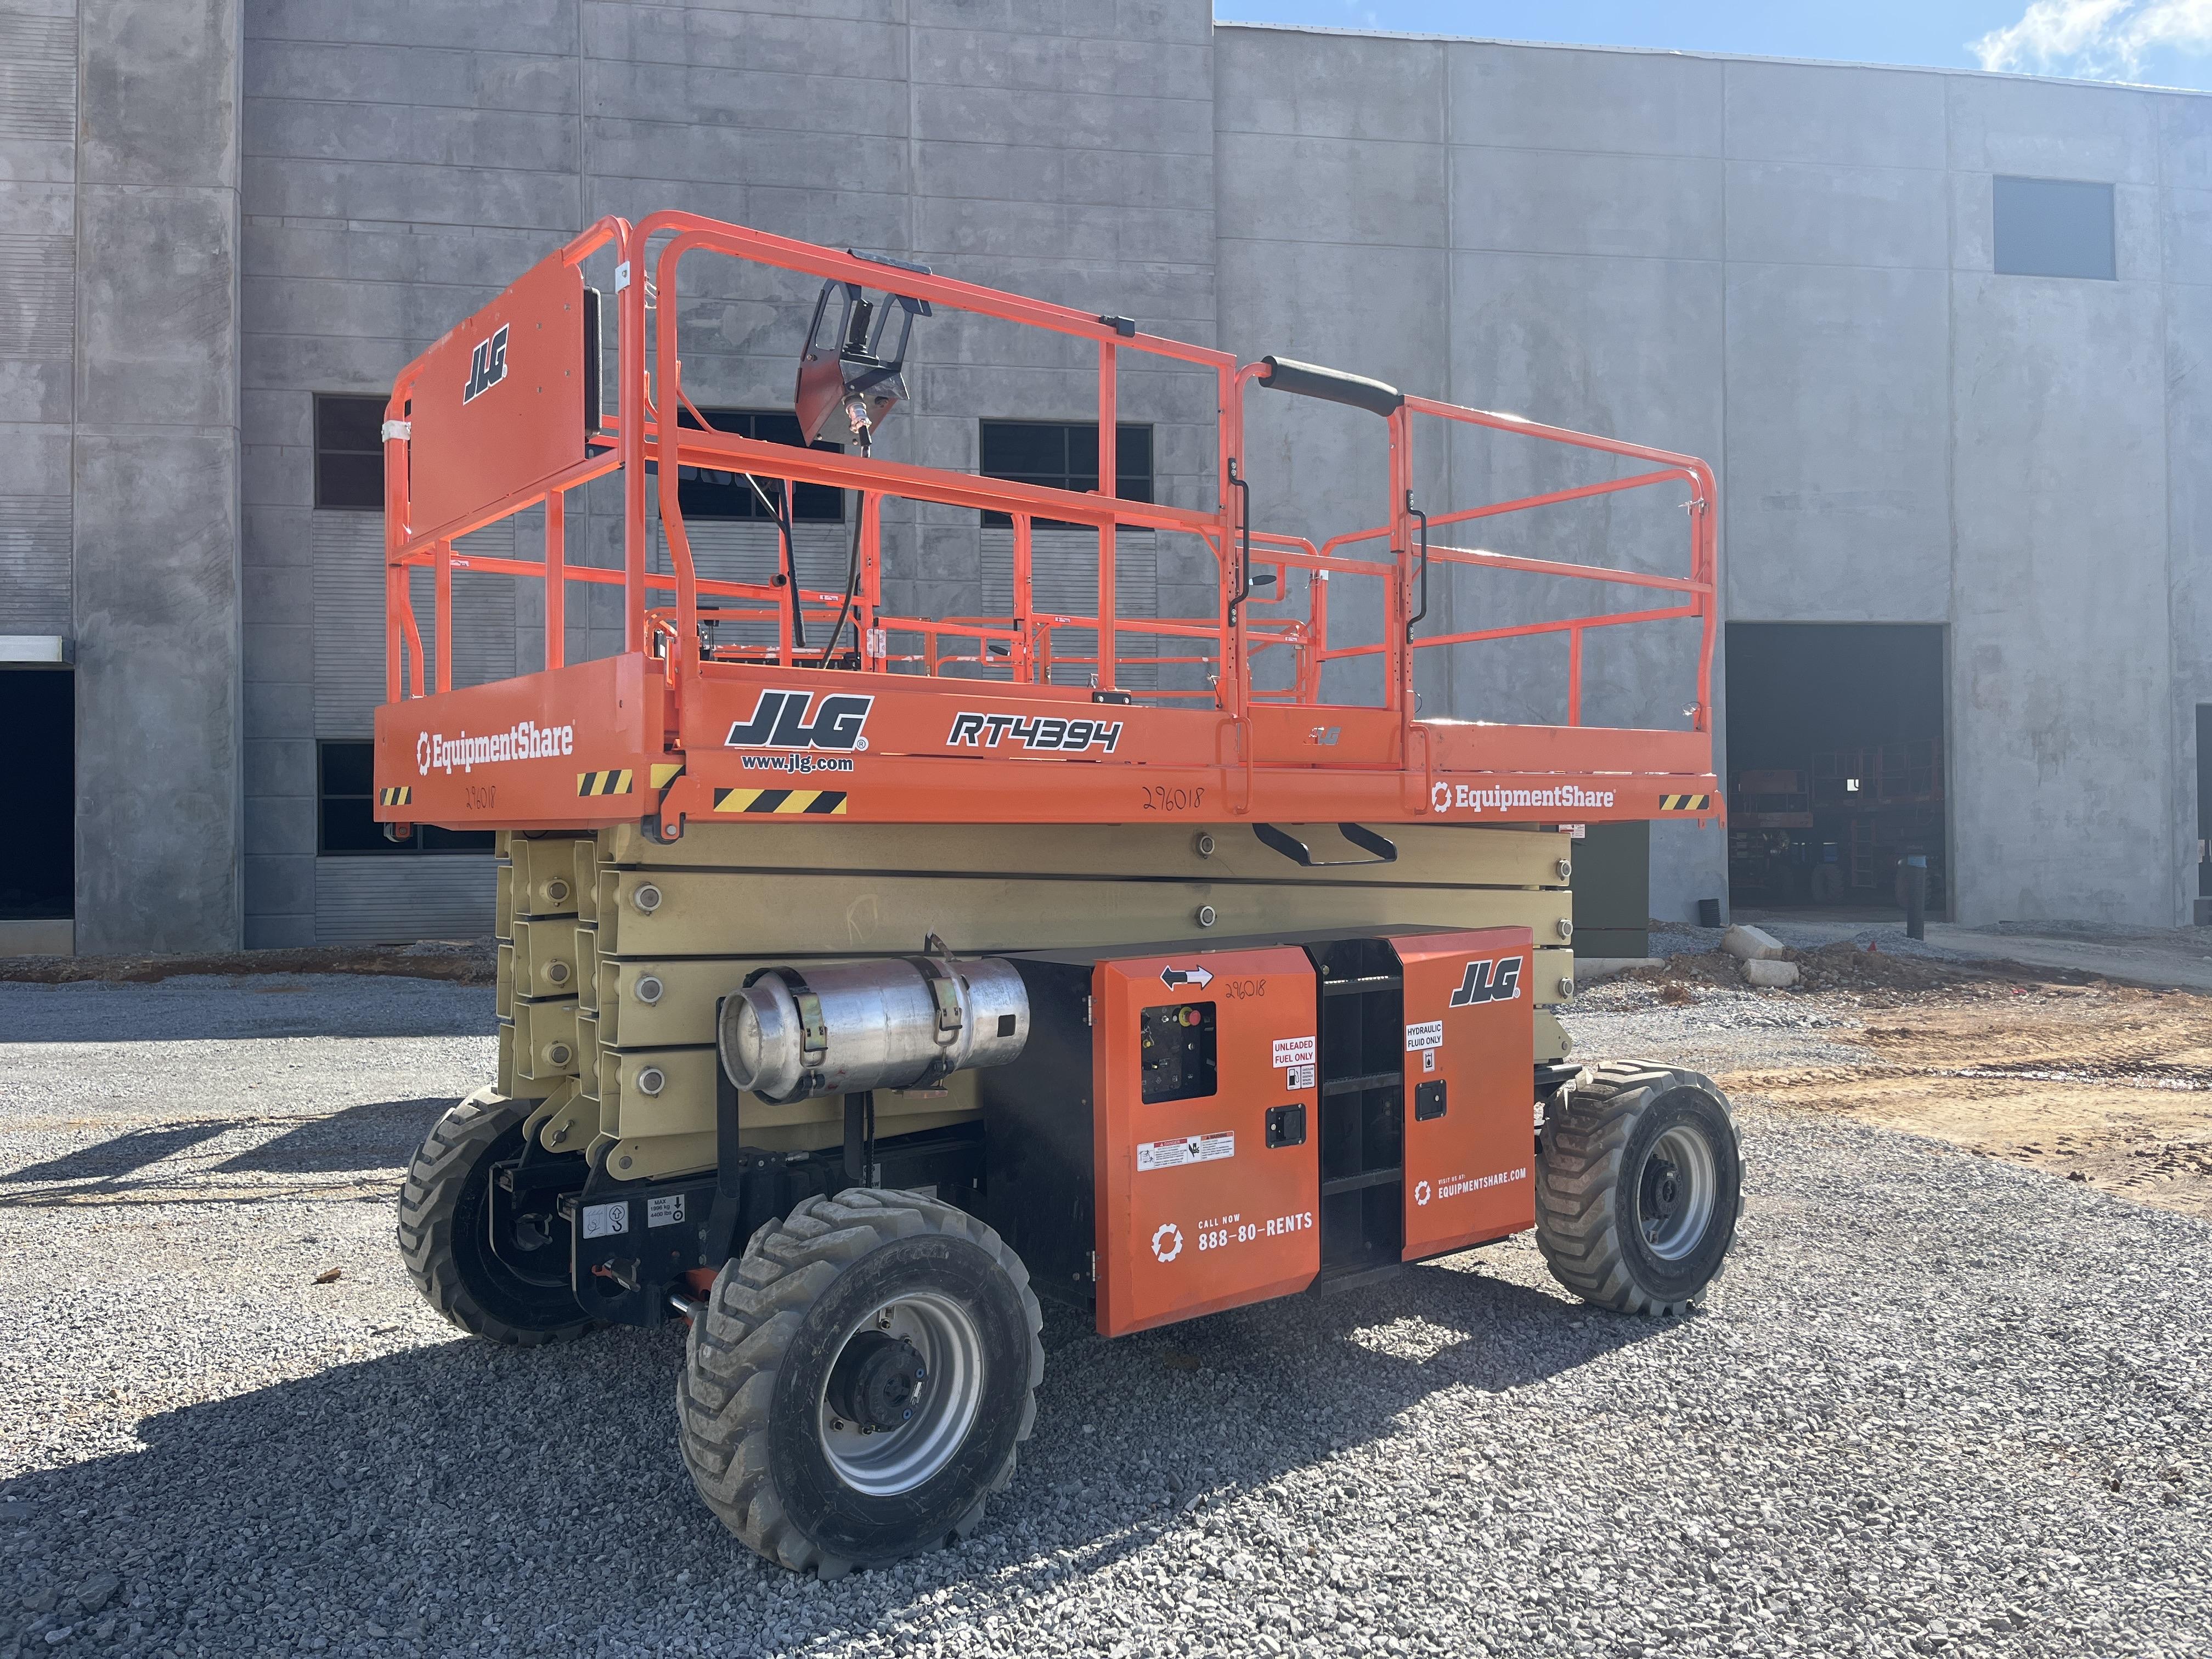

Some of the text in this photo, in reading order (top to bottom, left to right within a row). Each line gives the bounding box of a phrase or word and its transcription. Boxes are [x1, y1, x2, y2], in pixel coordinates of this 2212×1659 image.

[462, 323, 509, 405] JLG
[724, 689, 874, 751] JLG
[946, 712, 1123, 752] RT4394
[432, 720, 573, 775] EquipmentShare
[742, 754, 854, 772] www.jlg.com
[466, 785, 496, 809] 296018
[1142, 786, 1205, 811] 296018
[1455, 785, 1613, 812] EquipmentShare
[1226, 979, 1266, 1000] 296018
[1449, 956, 1523, 1008] JLG
[1407, 1024, 1441, 1036] HYDRAULIC
[1408, 1035, 1441, 1048] FLUID ONLY
[1275, 1040, 1313, 1052] UNLEADED
[1275, 1052, 1313, 1064] FUEL ONLY
[1438, 1167, 1526, 1199] EQUIPMENTSHARE.COM
[1198, 1214, 1240, 1229] CALL NOW
[1198, 1212, 1312, 1251] 888-80-RENTS
